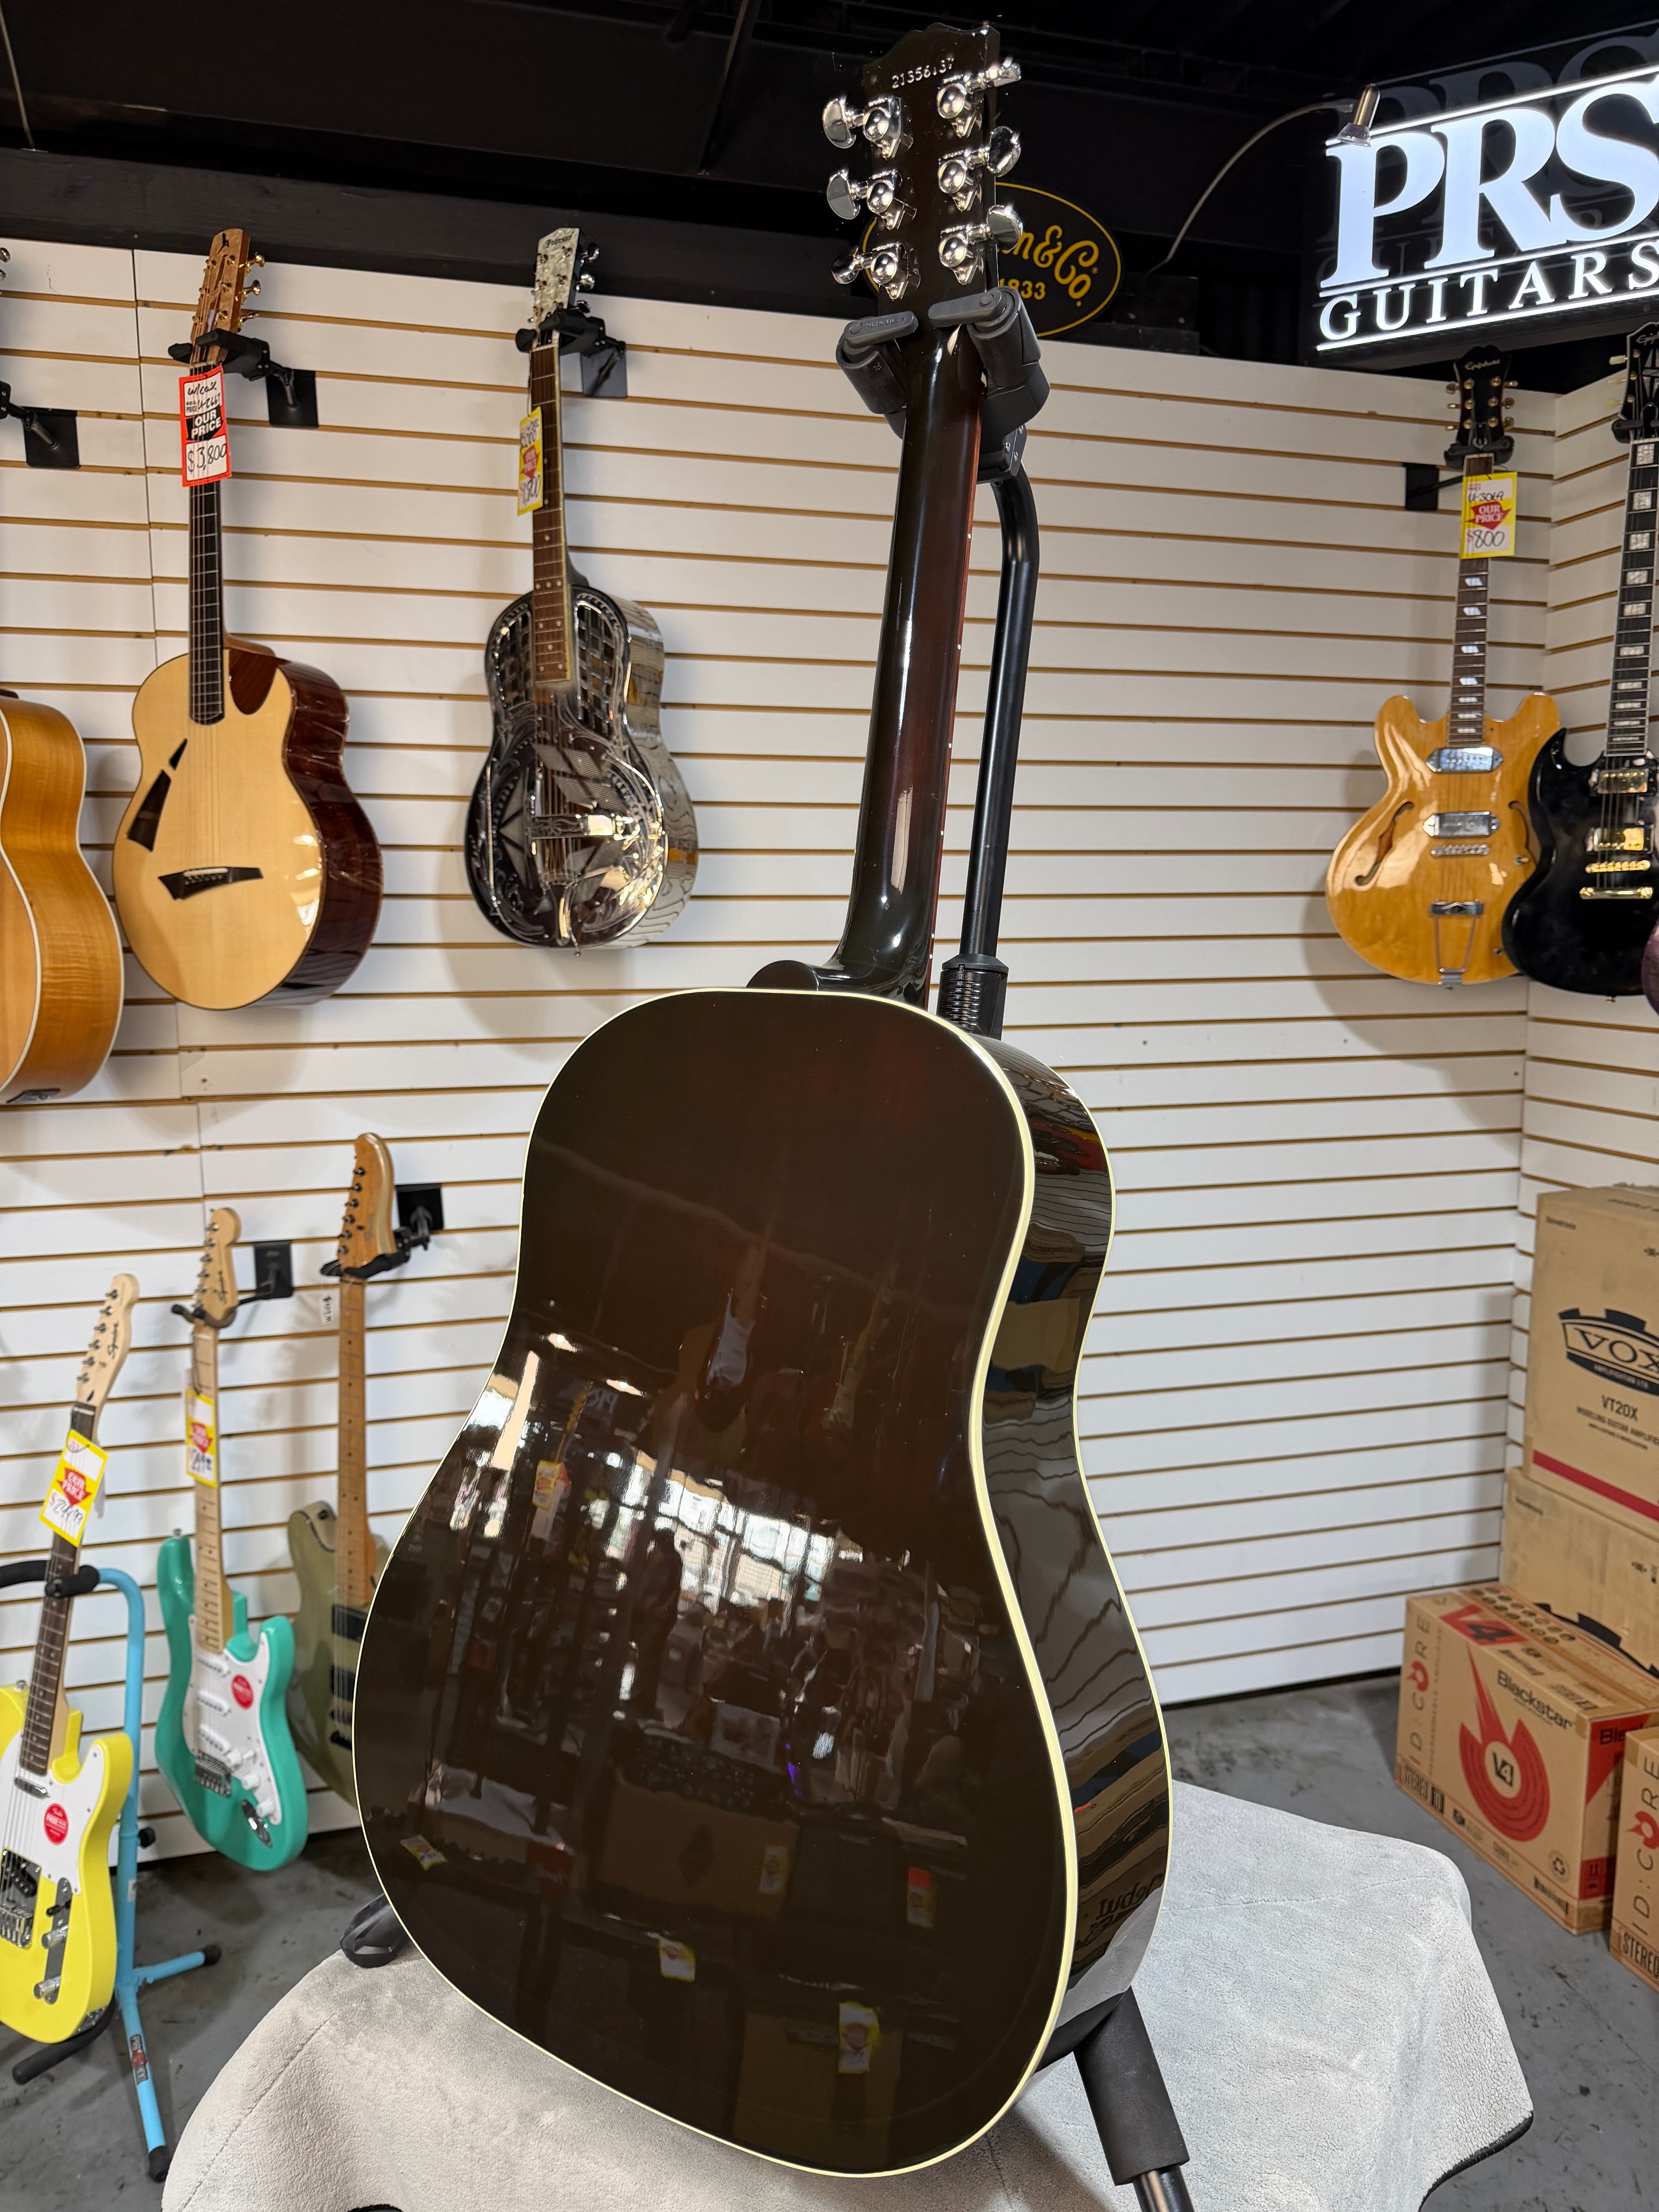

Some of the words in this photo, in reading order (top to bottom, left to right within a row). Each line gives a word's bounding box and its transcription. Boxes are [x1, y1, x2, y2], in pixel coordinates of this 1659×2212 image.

[1320, 77, 1659, 288] PRS
[1002, 225, 1099, 307] n&Co.
[1320, 239, 1659, 340] GUITARS
[191, 416, 222, 439] PRICE
[195, 410, 217, 427] OUR
[1475, 513, 1504, 524] PRICE
[1479, 505, 1500, 515] OUR
[1573, 1327, 1659, 1374] VOX
[1601, 1394, 1639, 1422] VT20X
[1497, 1669, 1573, 1730] Blackstar
